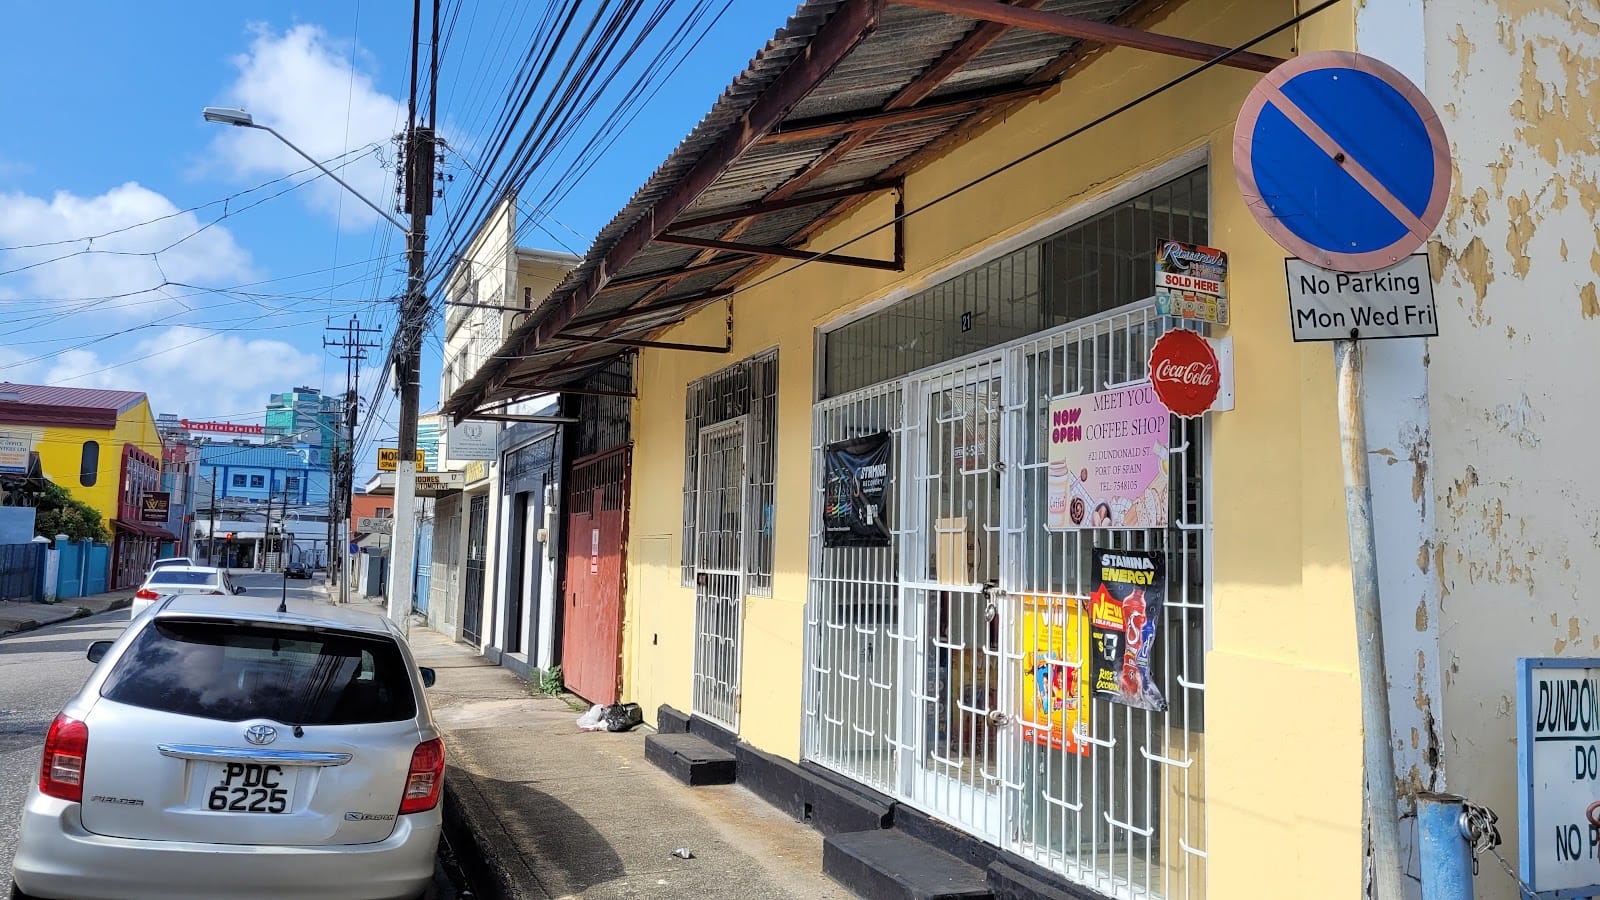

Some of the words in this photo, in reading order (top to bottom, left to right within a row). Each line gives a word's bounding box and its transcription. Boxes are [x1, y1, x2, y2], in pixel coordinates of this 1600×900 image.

[1165, 274, 1192, 288] SOLD
[1193, 278, 1219, 293] HERE
[1300, 275, 1330, 295] No
[1336, 272, 1420, 295] Parking
[962, 314, 971, 331] 21
[1296, 308, 1345, 329] Mon
[1350, 305, 1399, 327] Wed
[1404, 304, 1433, 325] Fri
[1156, 358, 1214, 386] Coca-Cola
[1093, 391, 1125, 412] MEET
[1126, 386, 1153, 408] YOU
[180, 418, 264, 434] Scotiabank
[1053, 407, 1082, 427] NOW
[1086, 420, 1129, 441] COFFEE
[1131, 415, 1165, 437] SHOP
[1052, 425, 1082, 444] OPEN
[1099, 447, 1141, 460] DUNDONALD
[1095, 465, 1111, 476] PORT
[1113, 465, 1121, 475] OF
[1122, 463, 1142, 474] SPAIN
[1101, 554, 1155, 570] STAMINA
[1101, 567, 1155, 585] ENERGY
[1092, 593, 1123, 623] NEW
[1536, 678, 1599, 733] DUNDON
[1575, 744, 1598, 781] DO
[225, 762, 282, 788] PDC
[208, 787, 288, 814] 6225
[1556, 824, 1582, 861] NO
